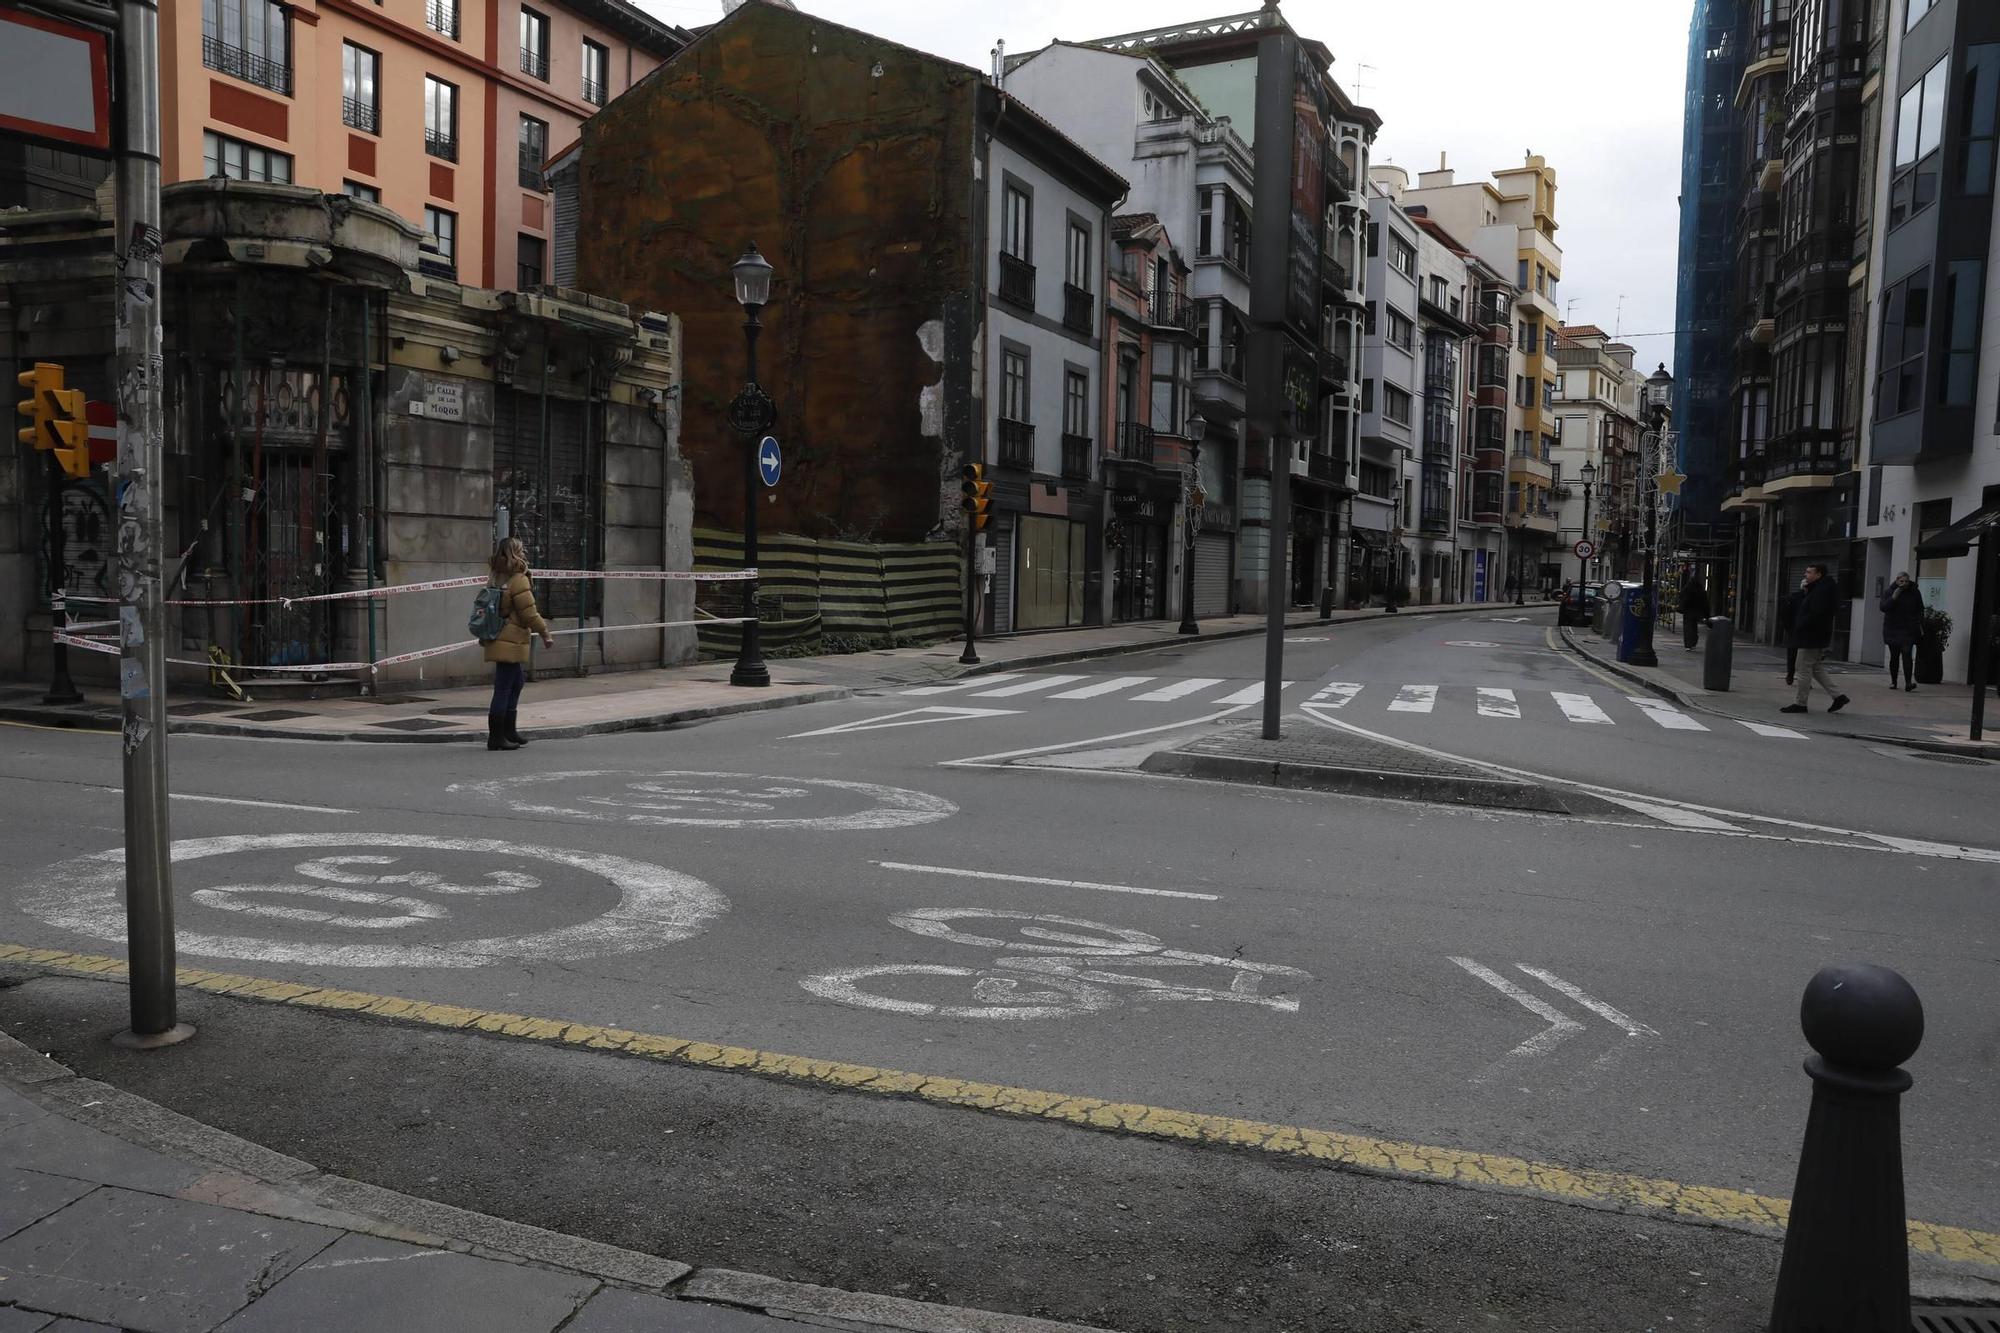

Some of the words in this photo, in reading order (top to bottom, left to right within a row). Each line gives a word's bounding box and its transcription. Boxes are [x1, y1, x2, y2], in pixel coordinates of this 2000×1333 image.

[437, 387, 456, 396] CALLE
[1578, 545, 1590, 553] 30
[191, 854, 542, 929] 30
